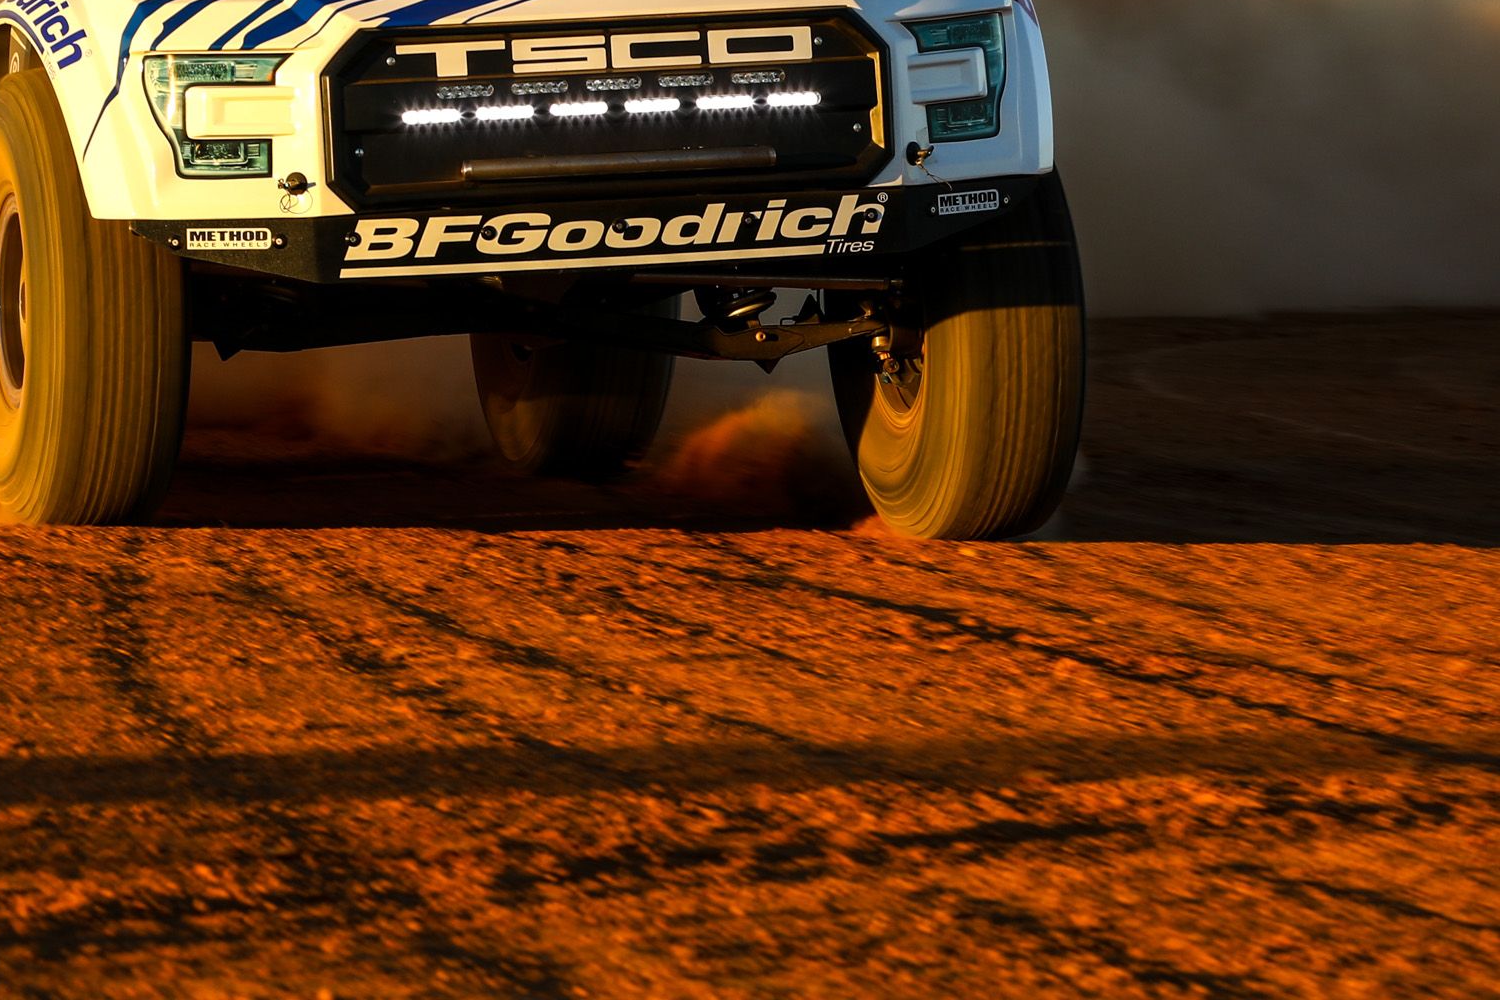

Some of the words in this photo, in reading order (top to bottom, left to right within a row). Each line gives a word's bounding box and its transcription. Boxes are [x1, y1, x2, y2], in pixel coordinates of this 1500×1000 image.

[395, 26, 812, 78] TSCO
[940, 191, 998, 207] METHOD
[964, 203, 998, 211] WHEELS
[344, 194, 886, 261] BFGoodrich
[189, 231, 269, 242] METHOD
[826, 239, 875, 255] Tires
